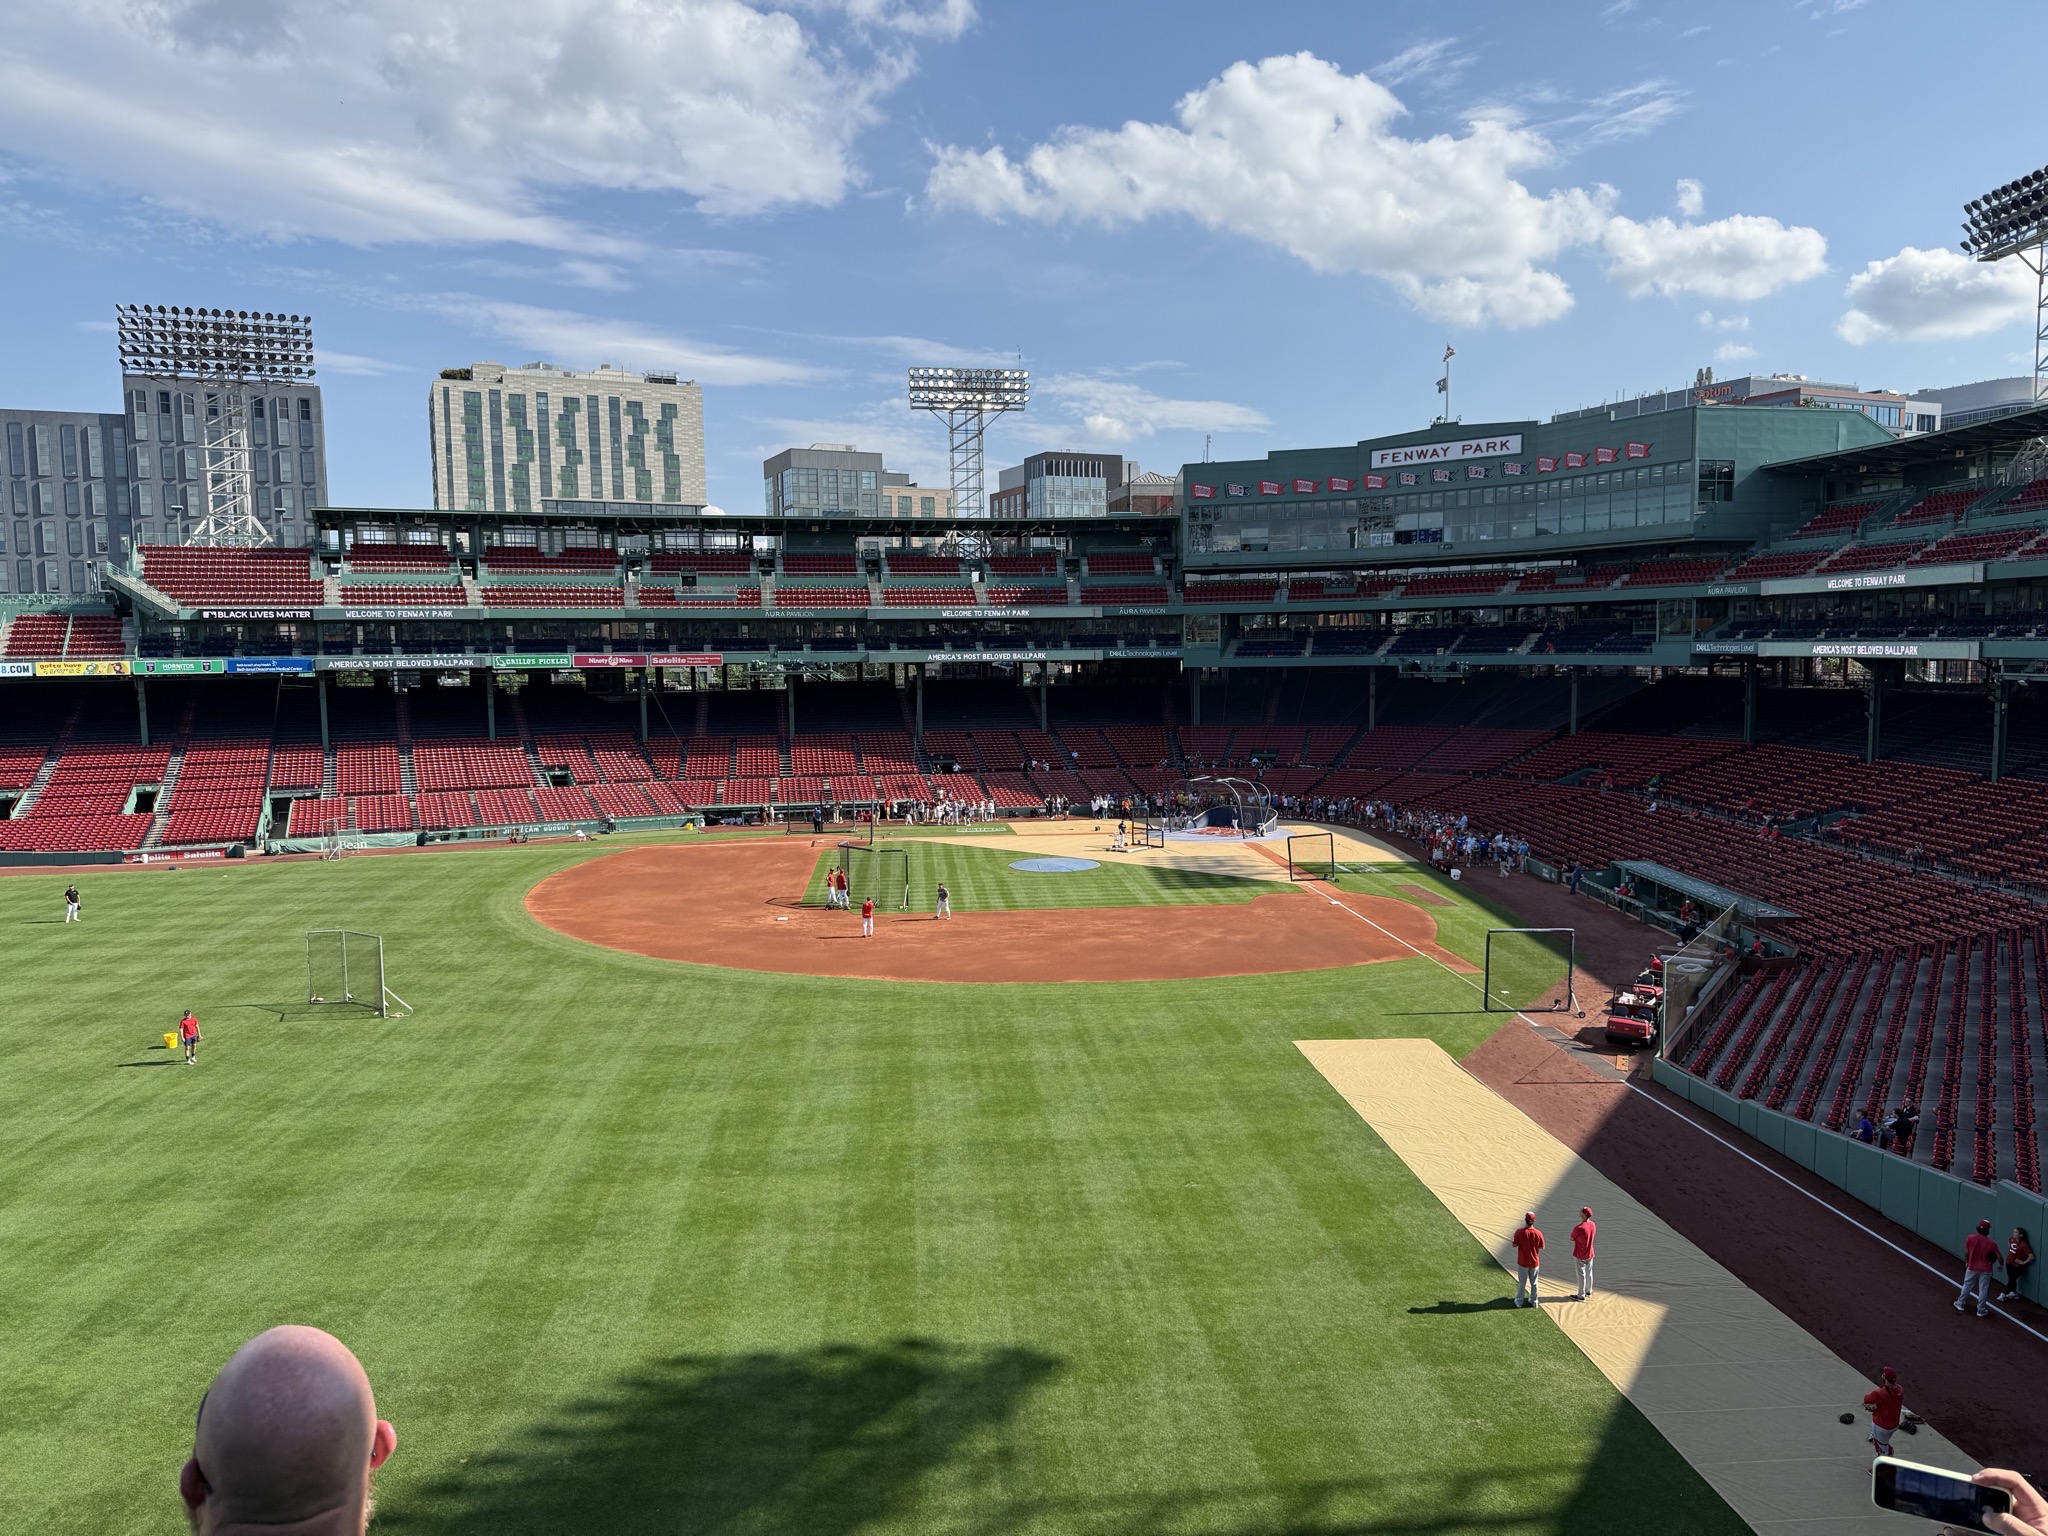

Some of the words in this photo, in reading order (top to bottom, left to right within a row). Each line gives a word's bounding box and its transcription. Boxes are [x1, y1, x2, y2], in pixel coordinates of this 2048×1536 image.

[1380, 446, 1450, 464] FENWAY
[1461, 440, 1510, 455] PARK
[1827, 579, 1853, 588] WELCOME
[1854, 578, 1862, 587] TO
[1862, 576, 1888, 586] FENWAY
[1888, 574, 1906, 584] PARK
[1724, 586, 1748, 594] PAVILION
[217, 611, 248, 619] BLACK
[276, 610, 311, 618] MATTER
[345, 610, 383, 618] WELCOME
[385, 610, 396, 618] TO
[1740, 643, 1754, 652] Level
[1812, 645, 1840, 654] AMERICA'S
[1840, 645, 1857, 655] MOST
[1857, 645, 1884, 655] BELOVED
[1884, 645, 1918, 655] BALLPARK
[652, 656, 687, 664] Safelite
[1012, 652, 1046, 660] BALLPARK
[328, 660, 370, 669] AMERICA'S
[372, 660, 394, 668] MOST
[396, 659, 432, 667] BELOVED
[433, 659, 474, 667] BALLPARK
[538, 657, 569, 665] PICKLES
[588, 657, 608, 665] Ninety
[132, 853, 171, 862] Saelite
[183, 850, 221, 859] Safelite
